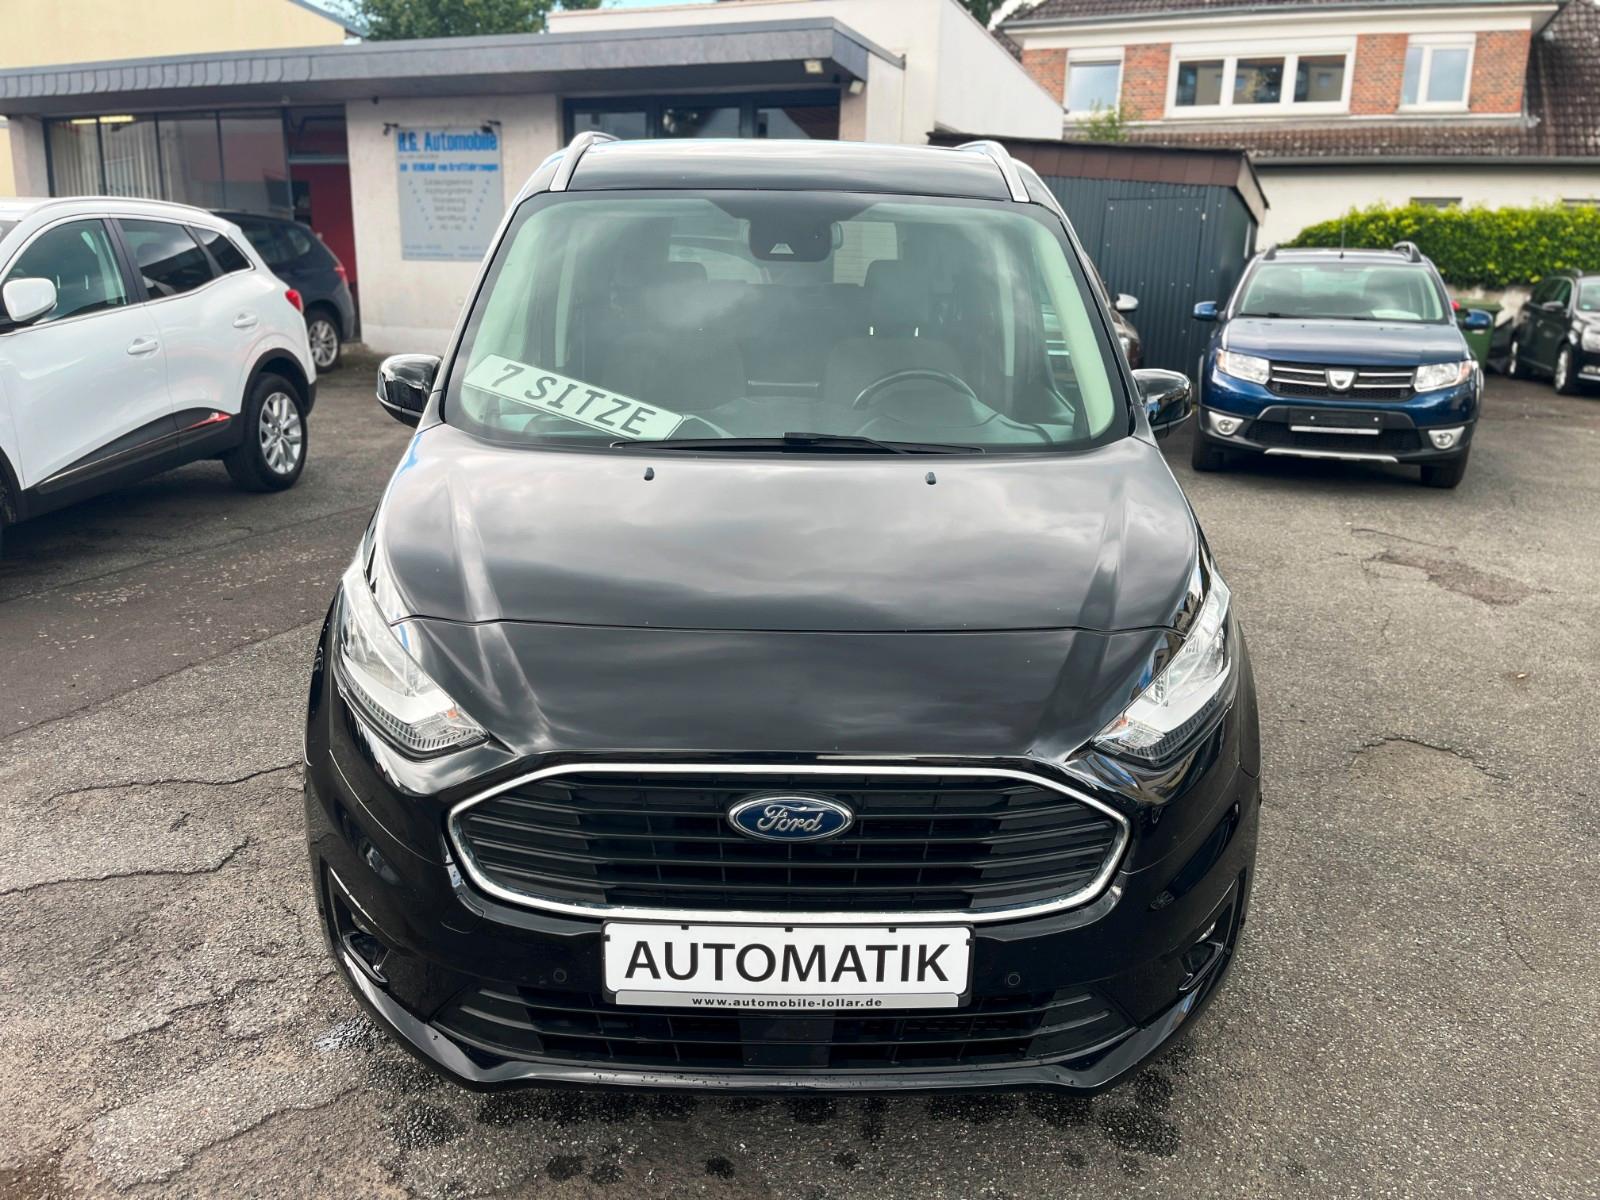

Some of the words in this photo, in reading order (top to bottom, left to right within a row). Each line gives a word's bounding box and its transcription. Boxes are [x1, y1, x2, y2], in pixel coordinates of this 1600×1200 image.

[424, 131, 497, 151] Automobile
[491, 363, 525, 388] 7
[524, 376, 657, 435] SITZE
[757, 804, 829, 832] Ford
[624, 940, 951, 983] AUTOMATIK
[692, 997, 882, 1008] www.automobile-lollar.de
